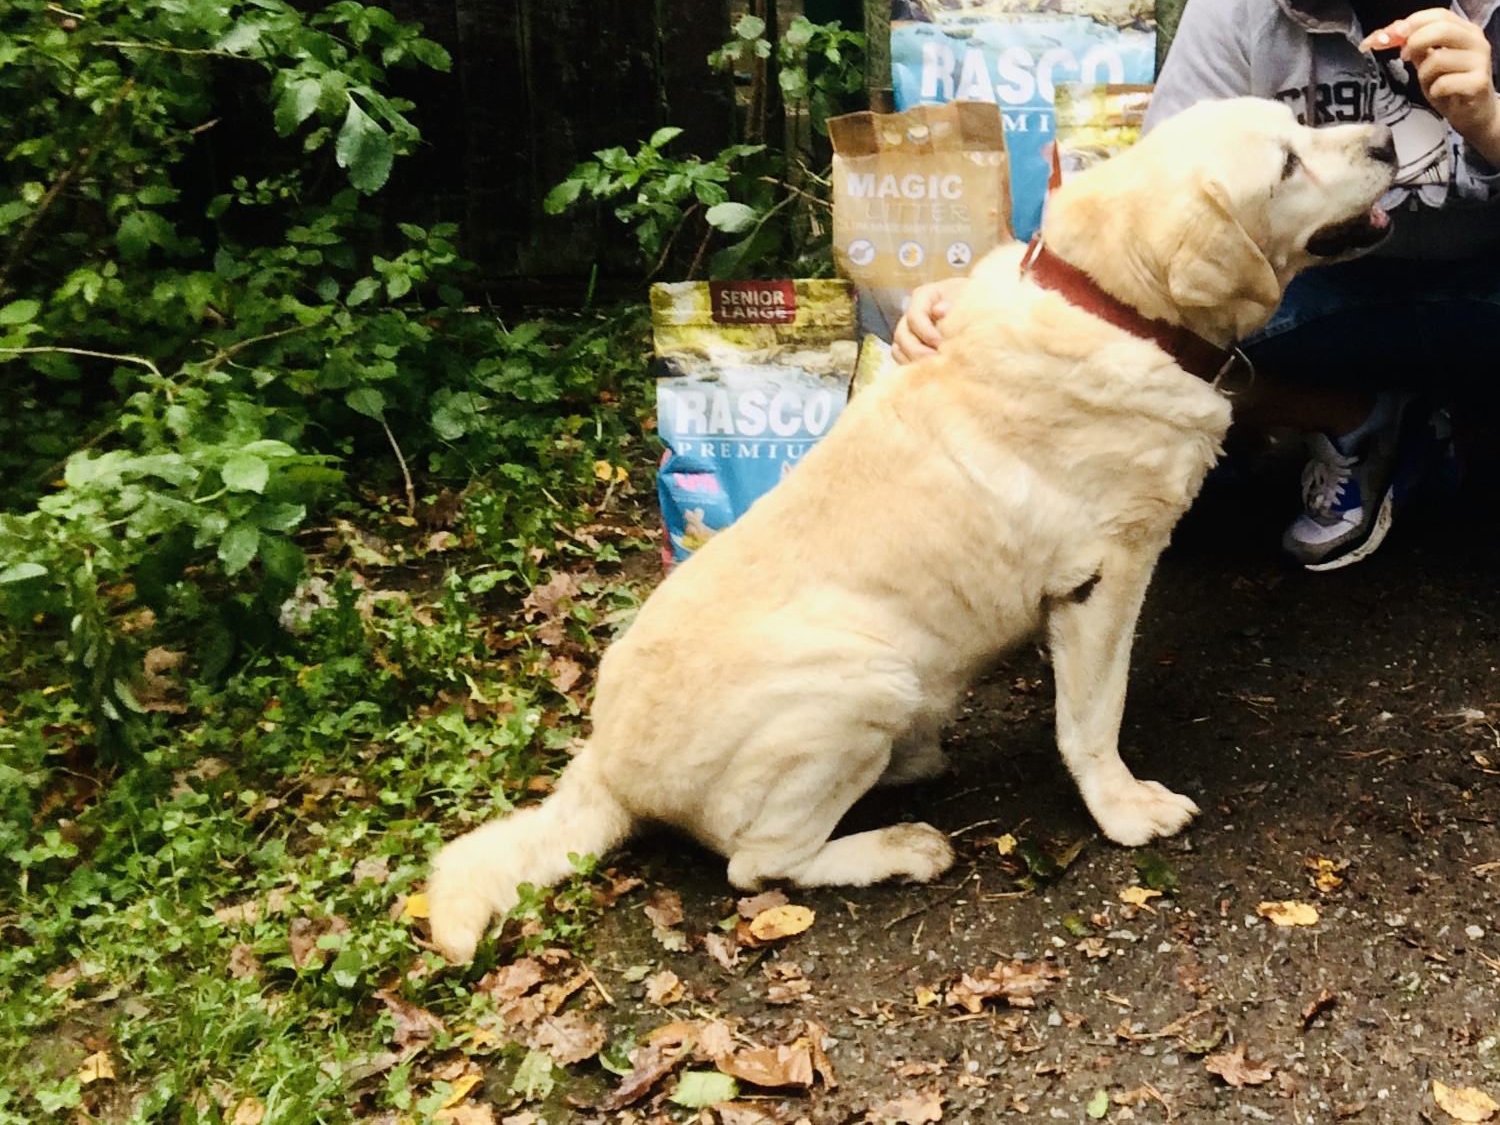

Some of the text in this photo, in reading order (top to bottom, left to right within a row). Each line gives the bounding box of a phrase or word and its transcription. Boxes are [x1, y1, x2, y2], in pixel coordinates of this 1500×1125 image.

[920, 42, 1125, 106] RASCO
[847, 173, 964, 200] MAGIC
[866, 201, 971, 221] LITTER
[720, 290, 785, 305] SENIOR
[721, 306, 788, 319] LARGE
[675, 388, 831, 436] RASCO
[677, 441, 817, 459] PREMIU
